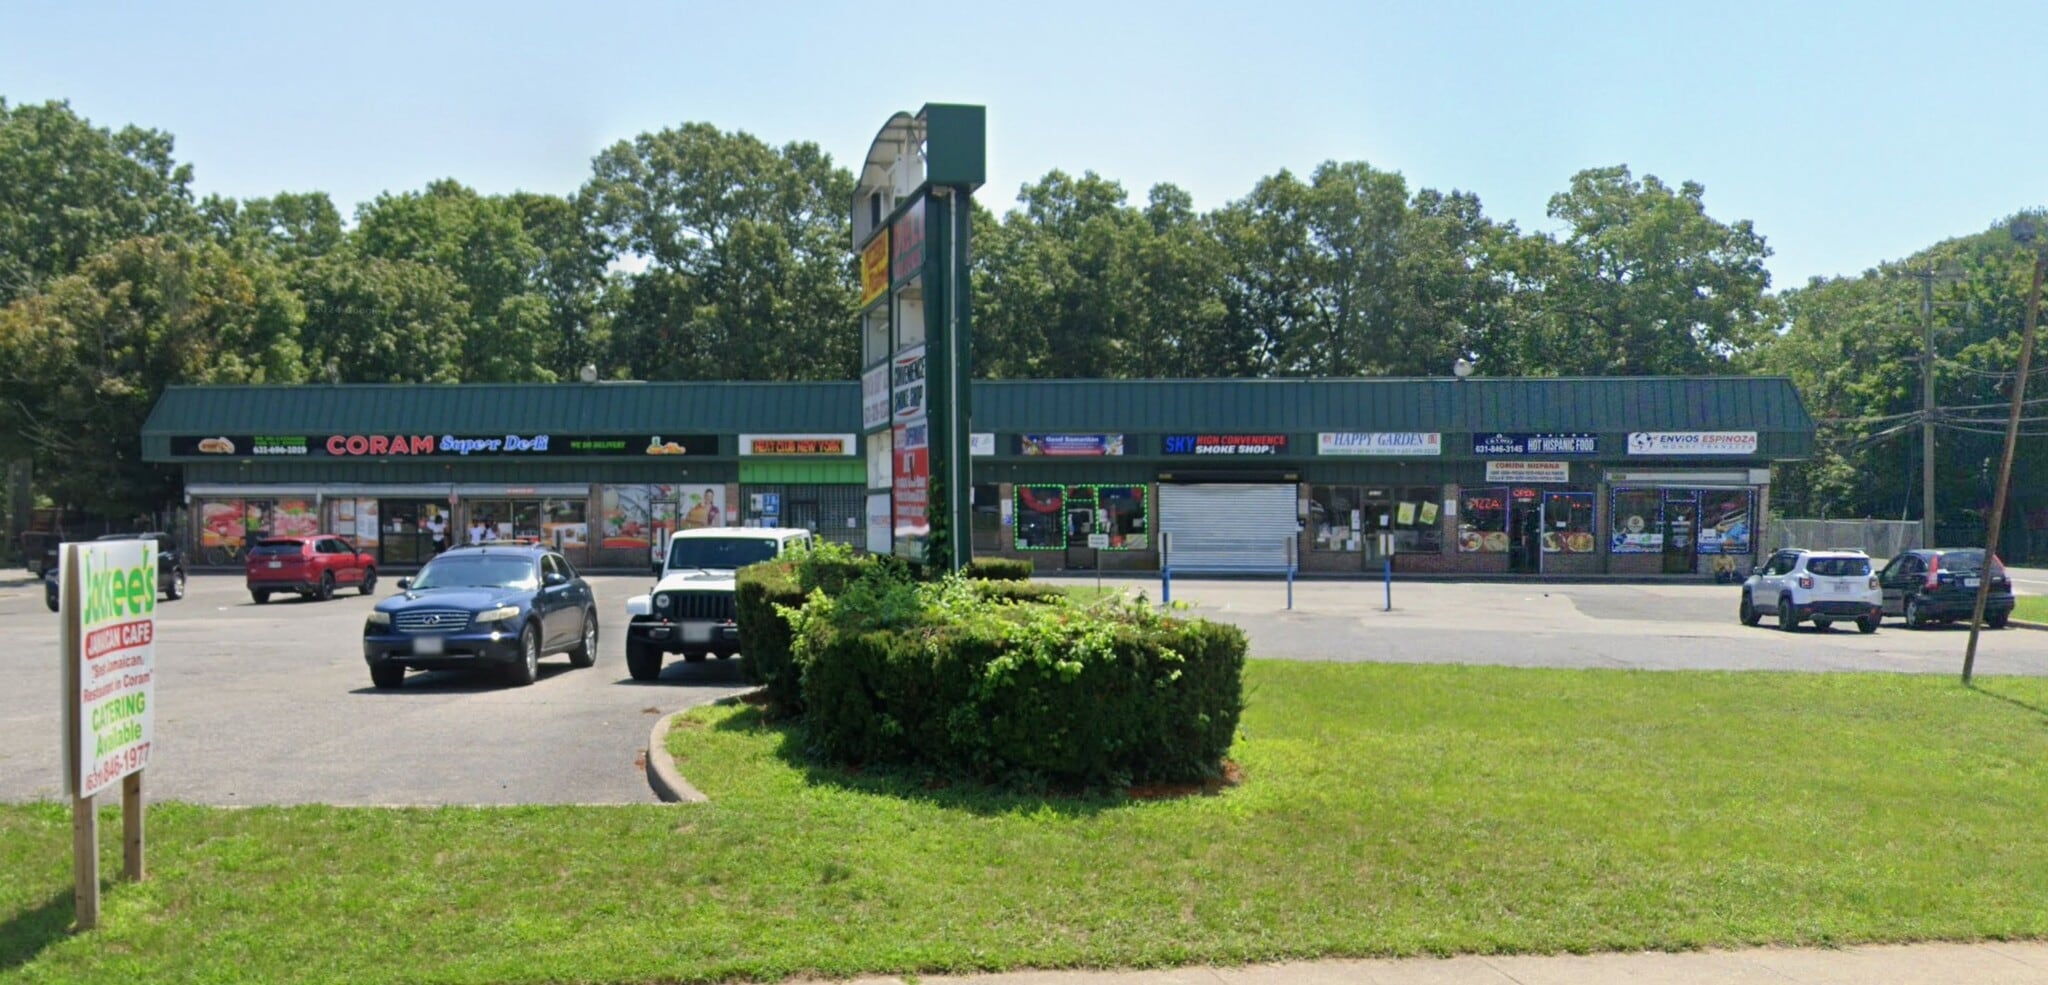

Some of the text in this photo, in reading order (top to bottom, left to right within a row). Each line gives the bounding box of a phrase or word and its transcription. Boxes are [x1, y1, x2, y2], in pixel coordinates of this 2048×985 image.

[327, 435, 434, 455] CORAM
[440, 434, 501, 455] Super
[503, 434, 549, 451] Deli
[1166, 436, 1195, 453] SKY
[1197, 435, 1286, 445] HIGH CONVENIENCE
[1334, 433, 1372, 446] HAPPY
[1377, 433, 1424, 446] GARDEN
[1528, 439, 1594, 451] HOT HISPANIC FOOD
[1196, 445, 1269, 454] SMOKE SHOP
[1513, 489, 1536, 497] OPEN
[122, 622, 151, 646] CAFE
[92, 692, 145, 732] CATERING
[95, 720, 142, 759] Available
